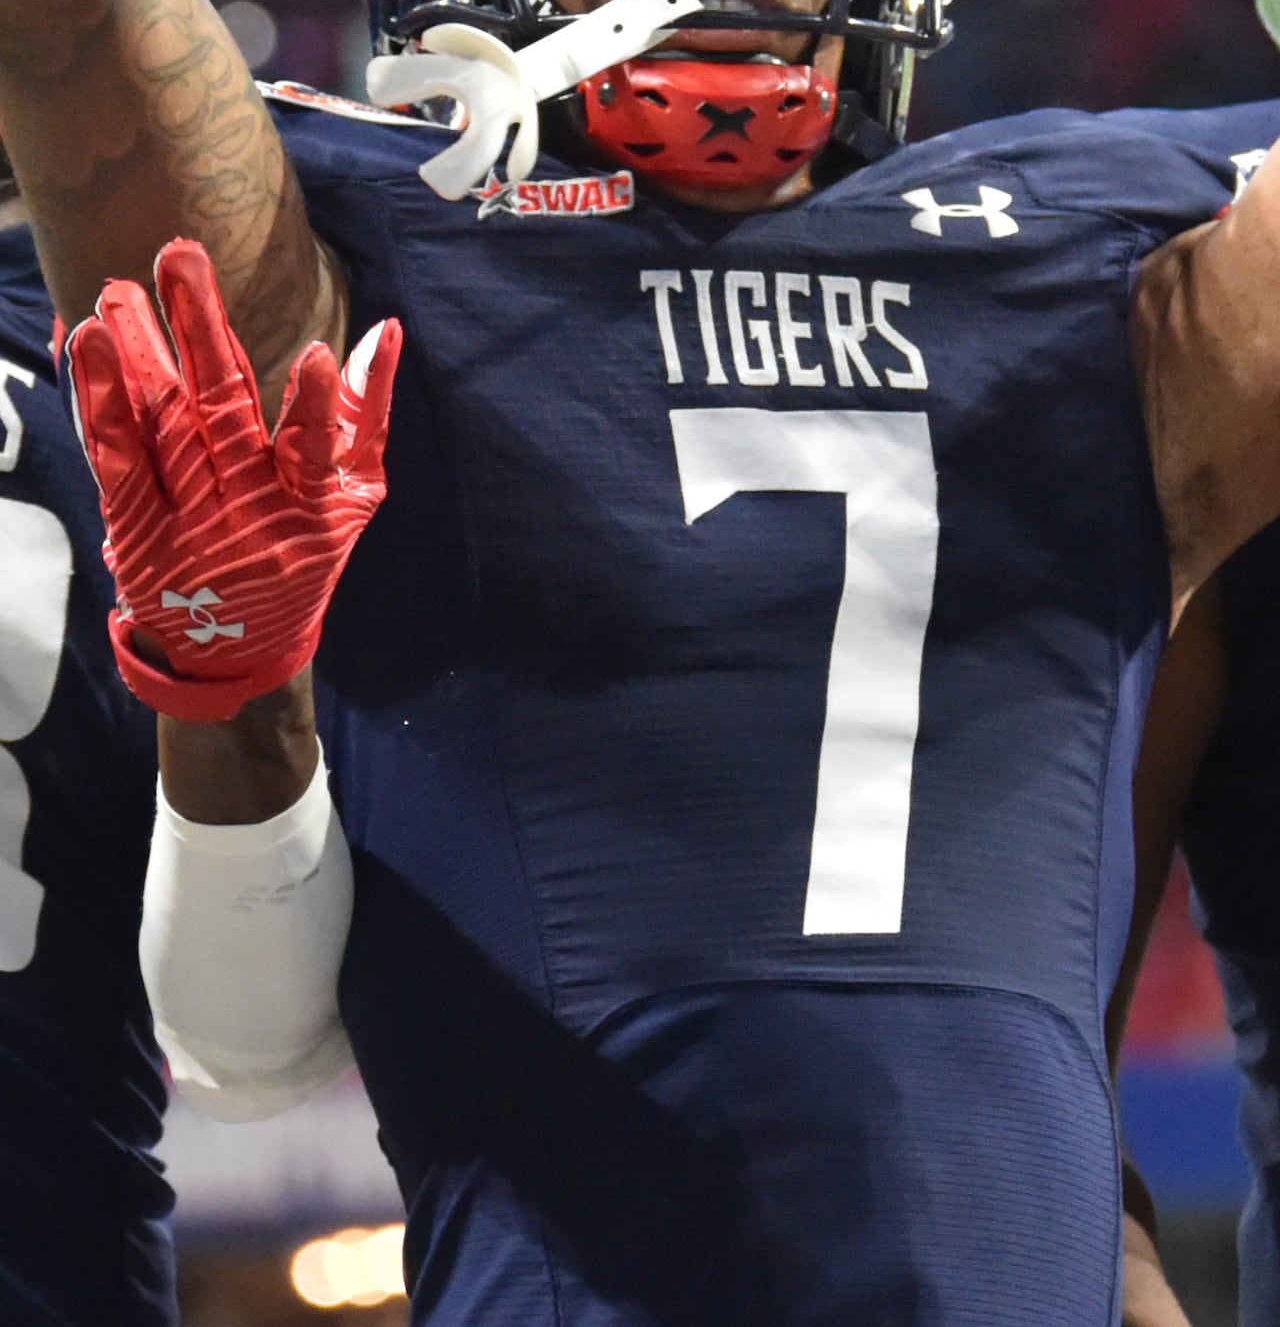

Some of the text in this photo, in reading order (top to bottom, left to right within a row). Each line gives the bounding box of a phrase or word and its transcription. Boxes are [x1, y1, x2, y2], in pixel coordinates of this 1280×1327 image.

[517, 175, 632, 214] SWAC
[640, 269, 928, 390] TIGERS
[669, 407, 940, 936] 7
